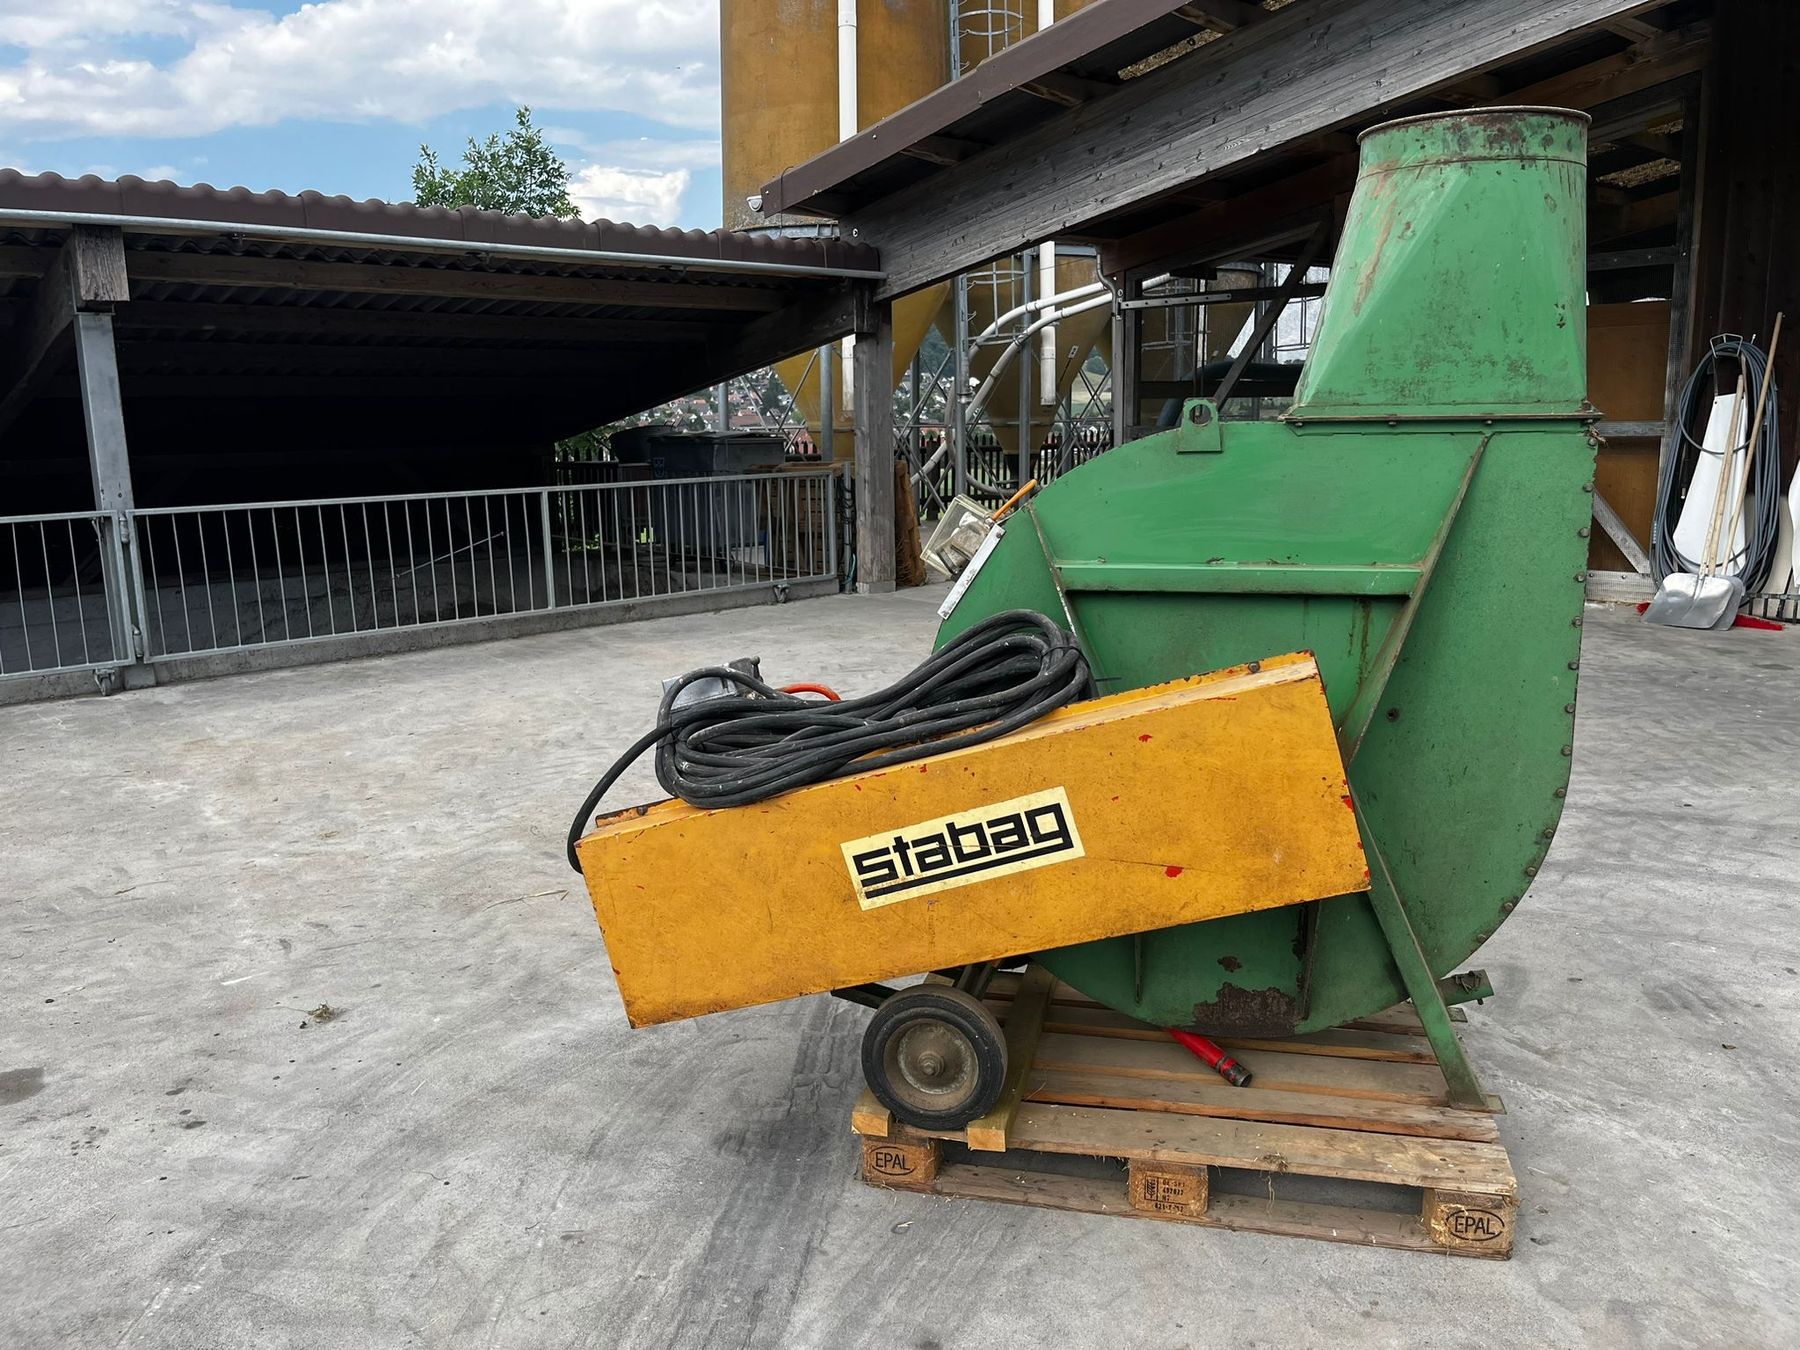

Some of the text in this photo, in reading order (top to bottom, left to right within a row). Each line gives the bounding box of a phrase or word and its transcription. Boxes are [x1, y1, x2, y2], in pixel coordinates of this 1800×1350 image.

[852, 802, 1074, 899] stabag
[875, 1151, 911, 1171] EPAL
[1454, 1215, 1496, 1235] EPAL
